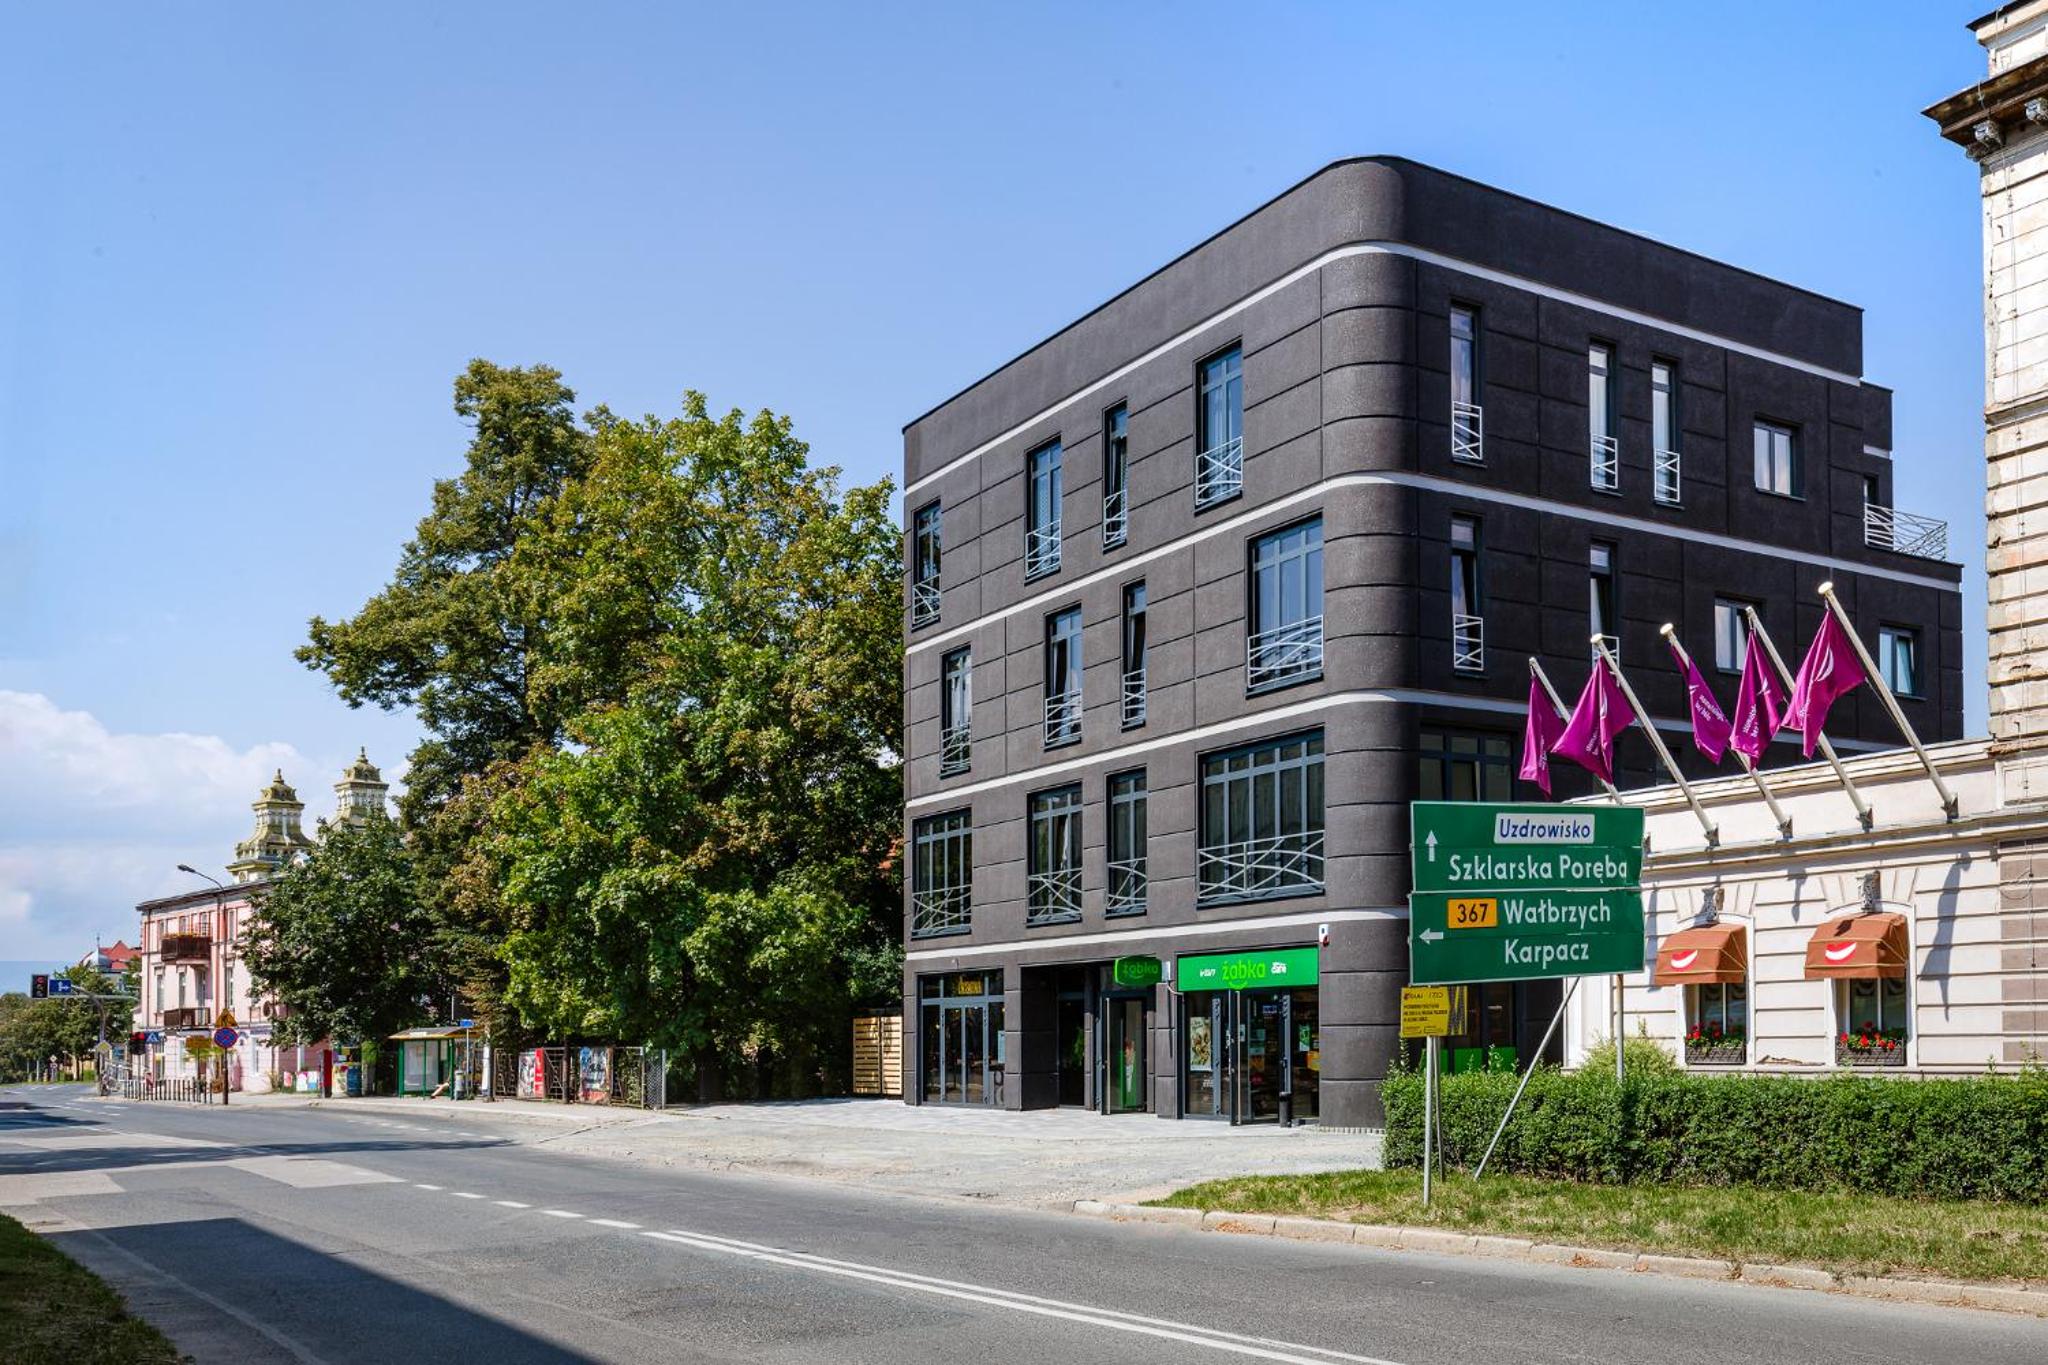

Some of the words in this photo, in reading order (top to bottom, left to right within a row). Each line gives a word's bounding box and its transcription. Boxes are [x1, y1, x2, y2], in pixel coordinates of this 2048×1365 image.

[1499, 818, 1591, 839] Uzdrowisko
[1448, 854, 1553, 881] Szklarska
[1559, 853, 1628, 883] Poręba
[1456, 903, 1489, 924] 367
[1503, 898, 1611, 929] Wałbrzych
[1504, 938, 1590, 969] Karpacz
[1222, 959, 1266, 980] żabka
